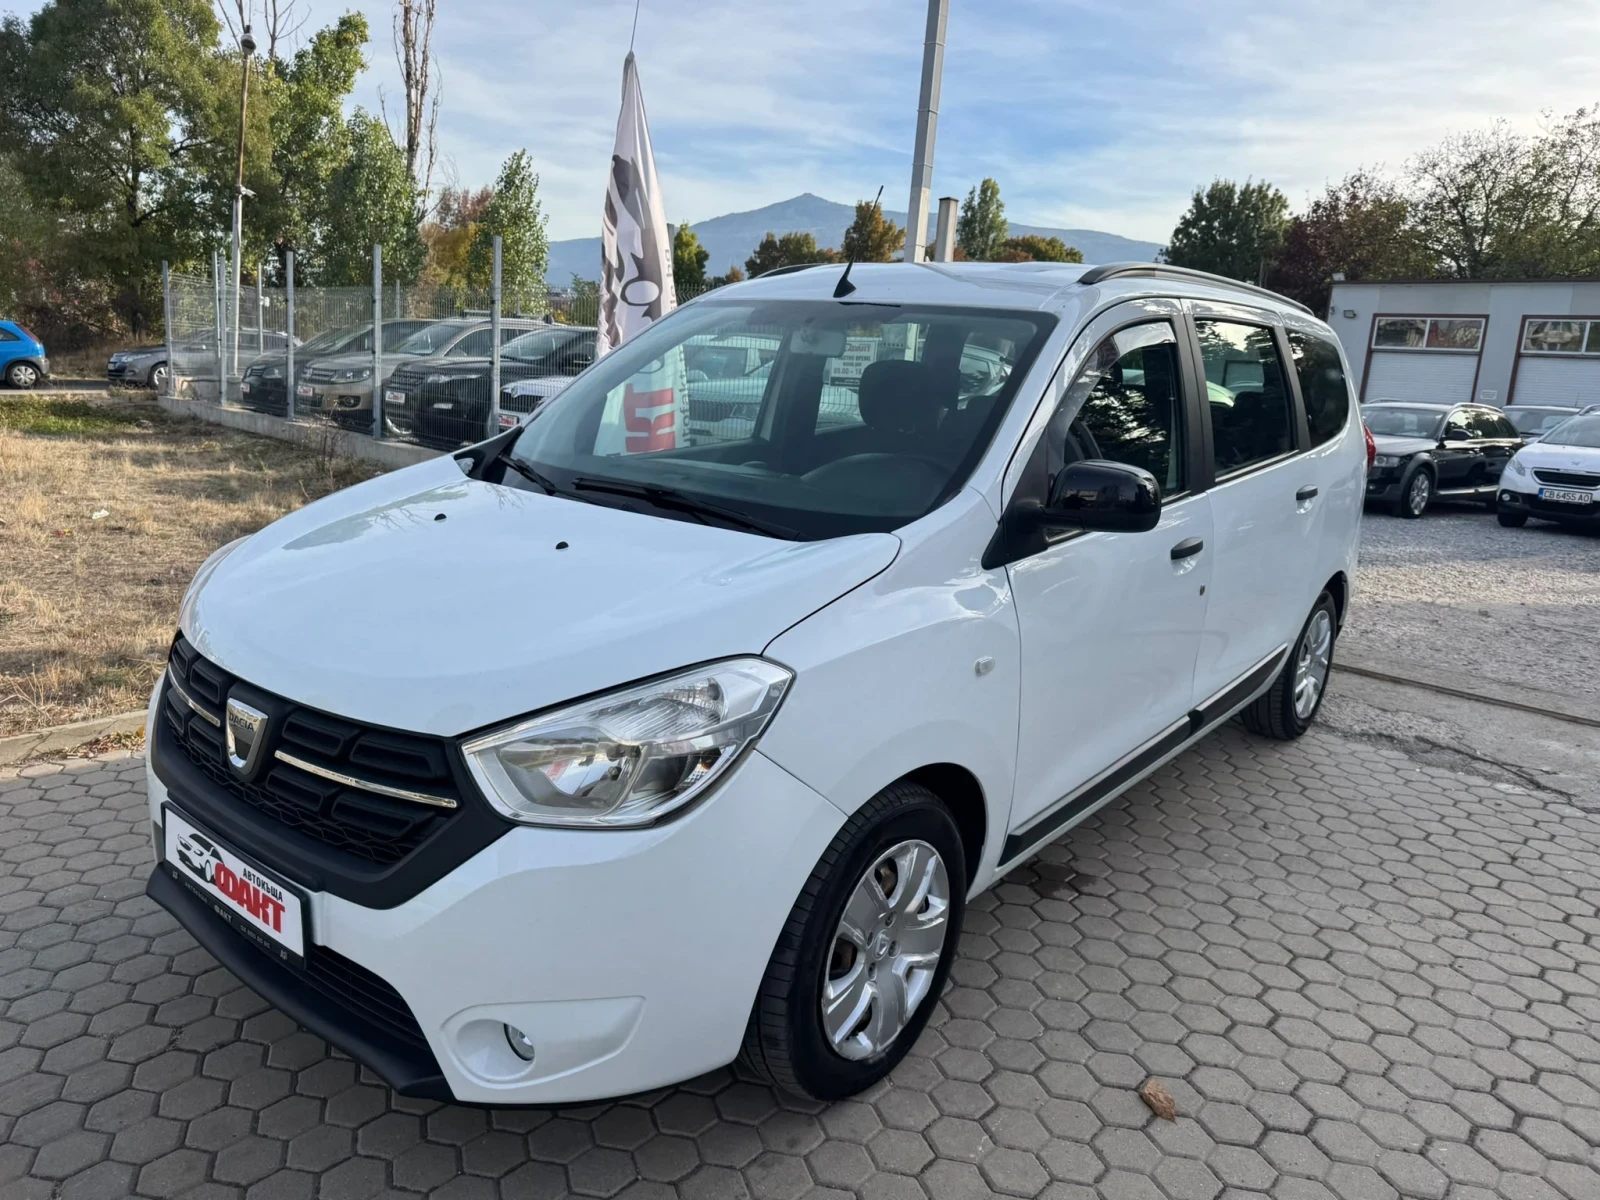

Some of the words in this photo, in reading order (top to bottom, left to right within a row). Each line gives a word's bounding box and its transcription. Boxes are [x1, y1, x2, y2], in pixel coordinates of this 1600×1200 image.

[229, 713, 254, 732] DACIA
[214, 862, 286, 934] ФАКТ
[242, 867, 284, 903] АВТОКЪЩА
